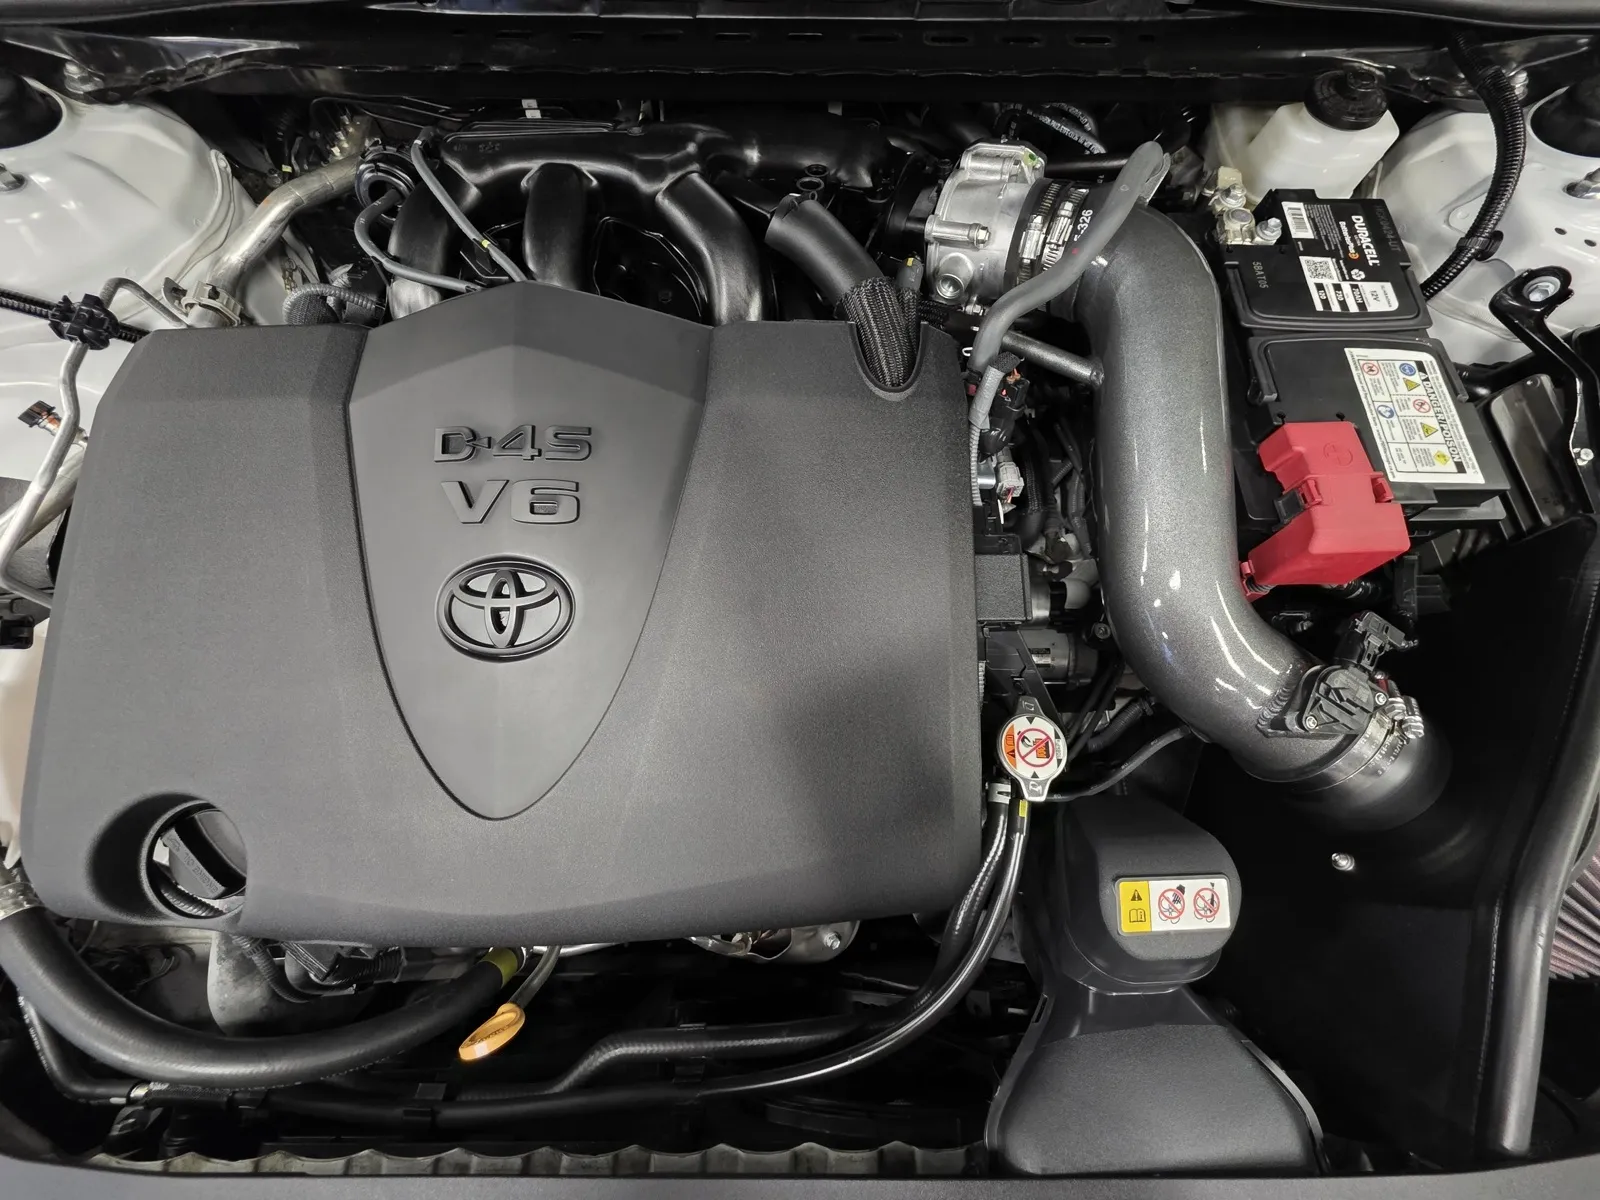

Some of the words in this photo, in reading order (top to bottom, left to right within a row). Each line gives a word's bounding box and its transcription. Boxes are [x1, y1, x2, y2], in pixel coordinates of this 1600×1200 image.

[1351, 215, 1379, 266] DURACELL
[1370, 290, 1380, 302] 12V
[1423, 381, 1461, 462] DANGER/POISON
[440, 479, 580, 524] V6
[183, 851, 195, 867] OIL
[192, 865, 219, 894] ENGINE
